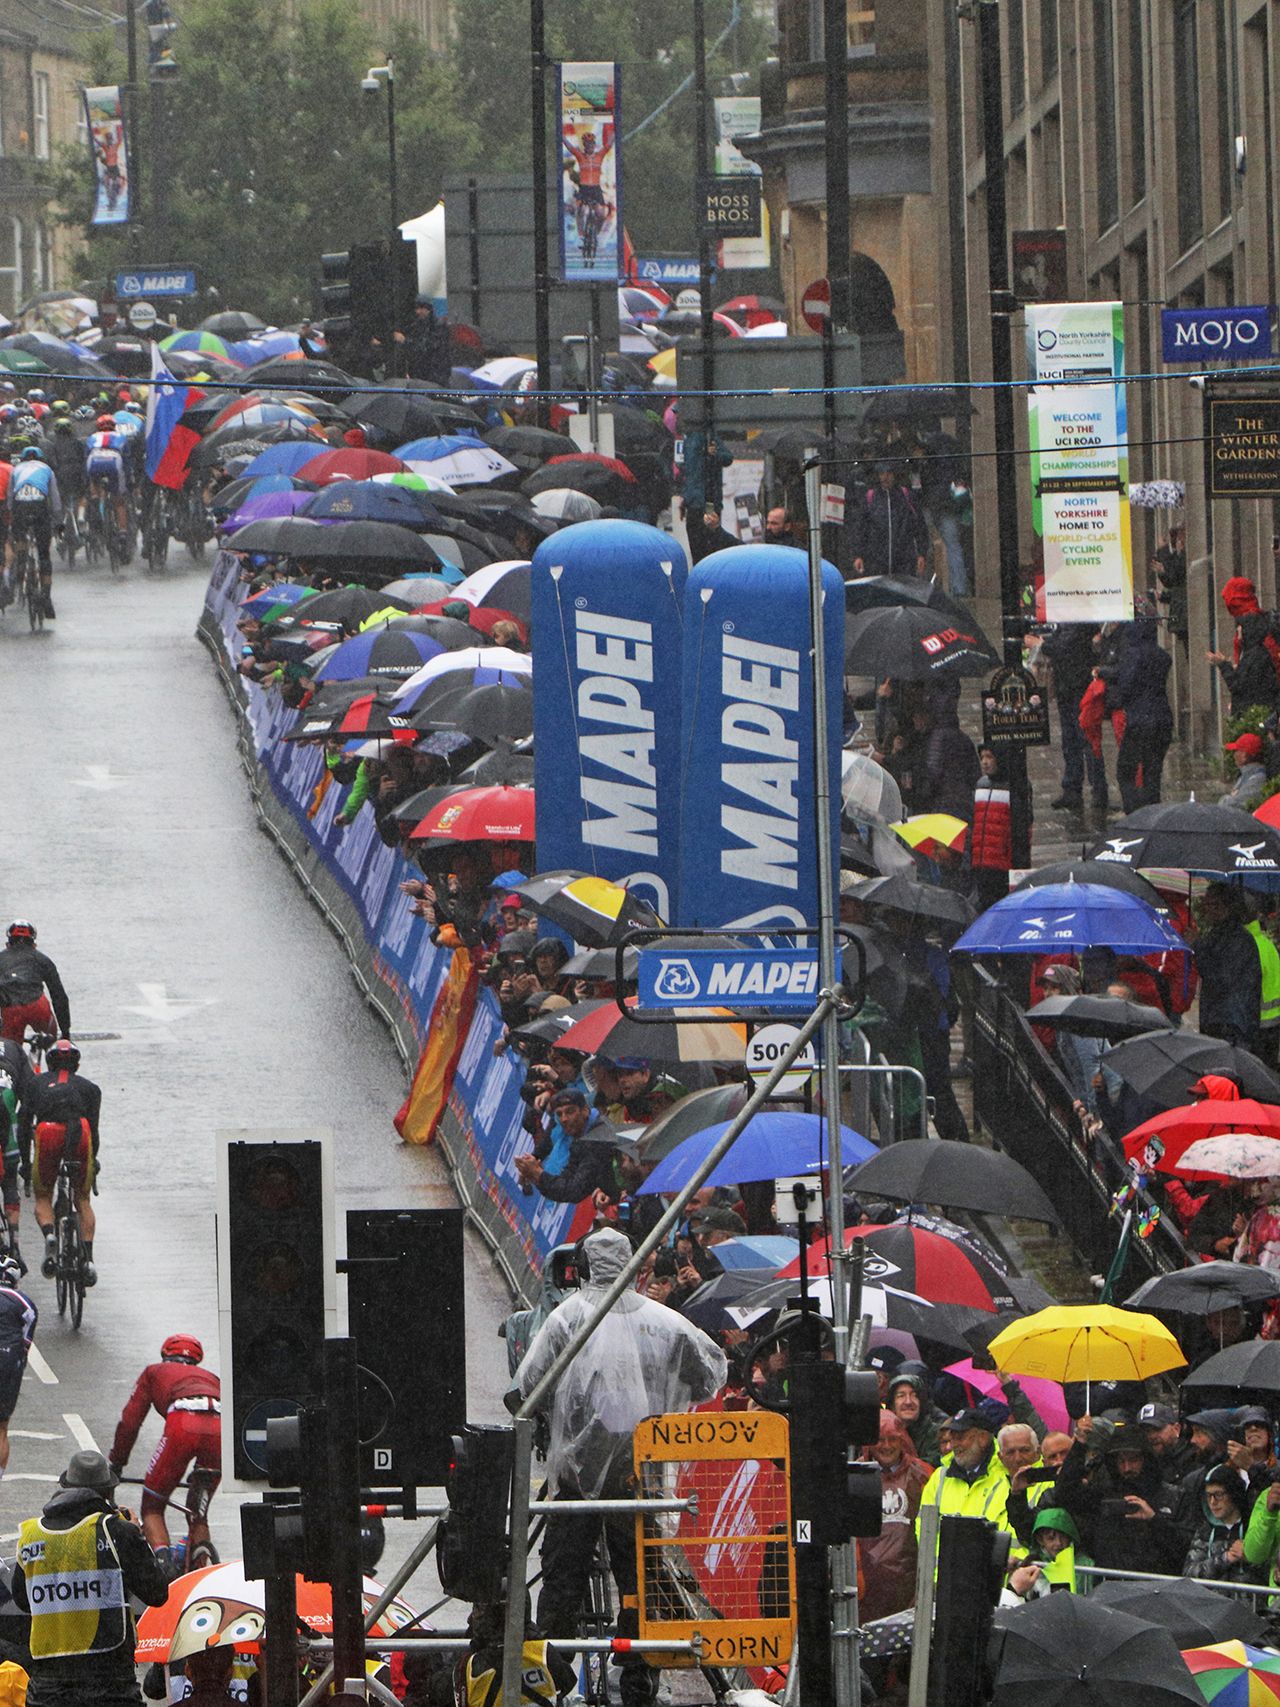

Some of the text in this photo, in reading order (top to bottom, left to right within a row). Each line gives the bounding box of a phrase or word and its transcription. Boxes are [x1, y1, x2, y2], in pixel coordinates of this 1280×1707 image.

[707, 195, 750, 207] MOSS
[707, 209, 753, 221] BROS.
[143, 276, 186, 291] MAPEI
[1079, 330, 1111, 338] Yorkshire
[1174, 319, 1259, 349] MOJO
[1043, 371, 1062, 379] UCI
[1052, 413, 1102, 422] WELCOME
[1235, 418, 1264, 430] THE
[1061, 425, 1094, 434] TO THE
[1055, 436, 1102, 446] UCI ROAD
[1220, 432, 1279, 445] WINTER
[1060, 449, 1097, 458] WORLD
[1041, 460, 1117, 470] CHAMPIONSHIPS
[1222, 472, 1278, 480] WETHERSPOON
[1064, 498, 1098, 506] NORTH
[1054, 509, 1109, 518] YORKSHIRE
[1059, 521, 1104, 530] HOME TO
[1047, 533, 1118, 543] WORLD-CLASS
[1061, 545, 1104, 554] CYCLING
[1065, 557, 1102, 566] EVENTS
[1046, 589, 1121, 597] northyorks.gov.uk/uci
[930, 649, 968, 669] VELOCITY
[378, 665, 421, 674] DUNLOP
[575, 609, 659, 857] MAPEI
[721, 633, 800, 889] MAPEI
[706, 962, 819, 995] MAPEI
[652, 1419, 760, 1445] ACORN
[378, 1451, 389, 1467] D
[800, 1523, 809, 1539] K
[672, 1636, 780, 1660] CORN
